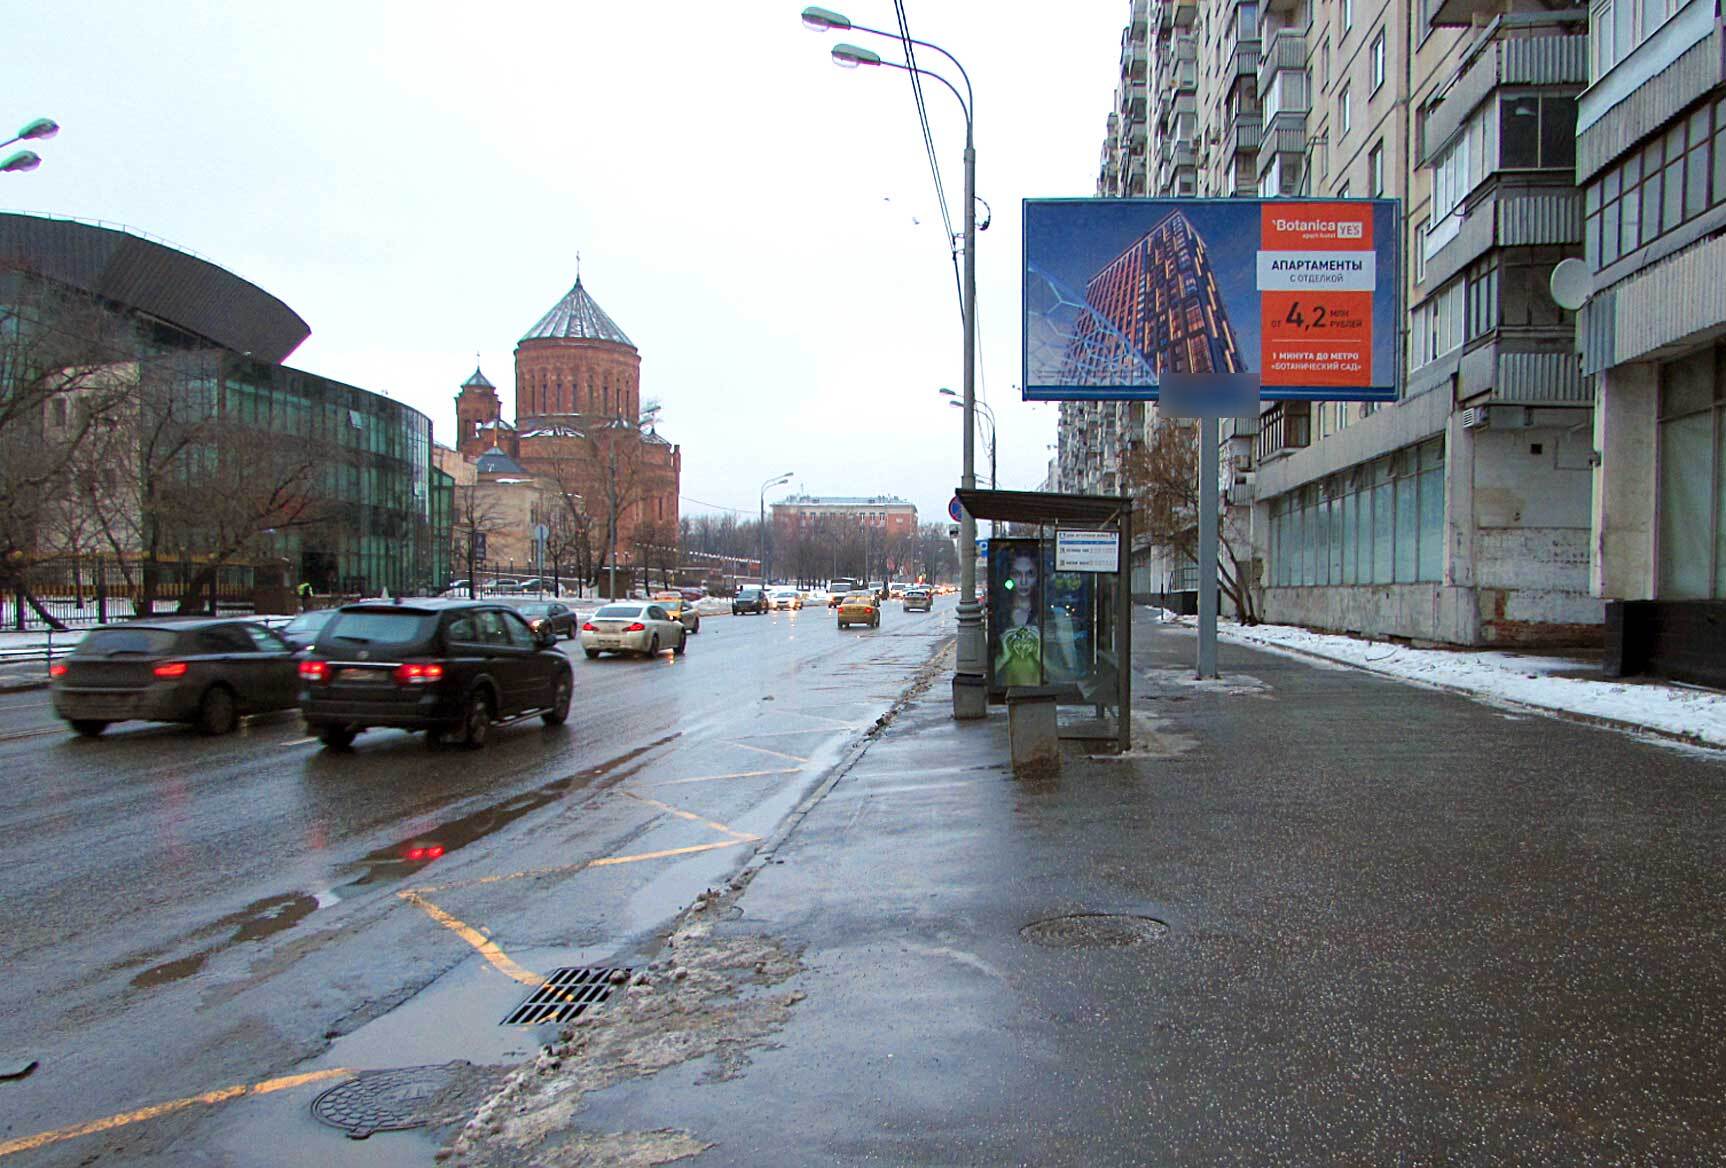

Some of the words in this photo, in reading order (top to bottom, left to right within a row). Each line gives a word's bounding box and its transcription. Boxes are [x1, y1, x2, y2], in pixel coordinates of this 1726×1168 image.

[1271, 260, 1363, 271] АПАРТАМЕНТЫ
[1289, 274, 1296, 282] С
[1297, 273, 1344, 283] ОТДЕЛКОЙ
[1286, 301, 1327, 331] 4,2
[1330, 320, 1363, 328] РУБЛЕЙ
[1280, 352, 1314, 360] МИНУТА
[1315, 352, 1329, 361] ДО
[1330, 352, 1359, 360] МЕТРО
